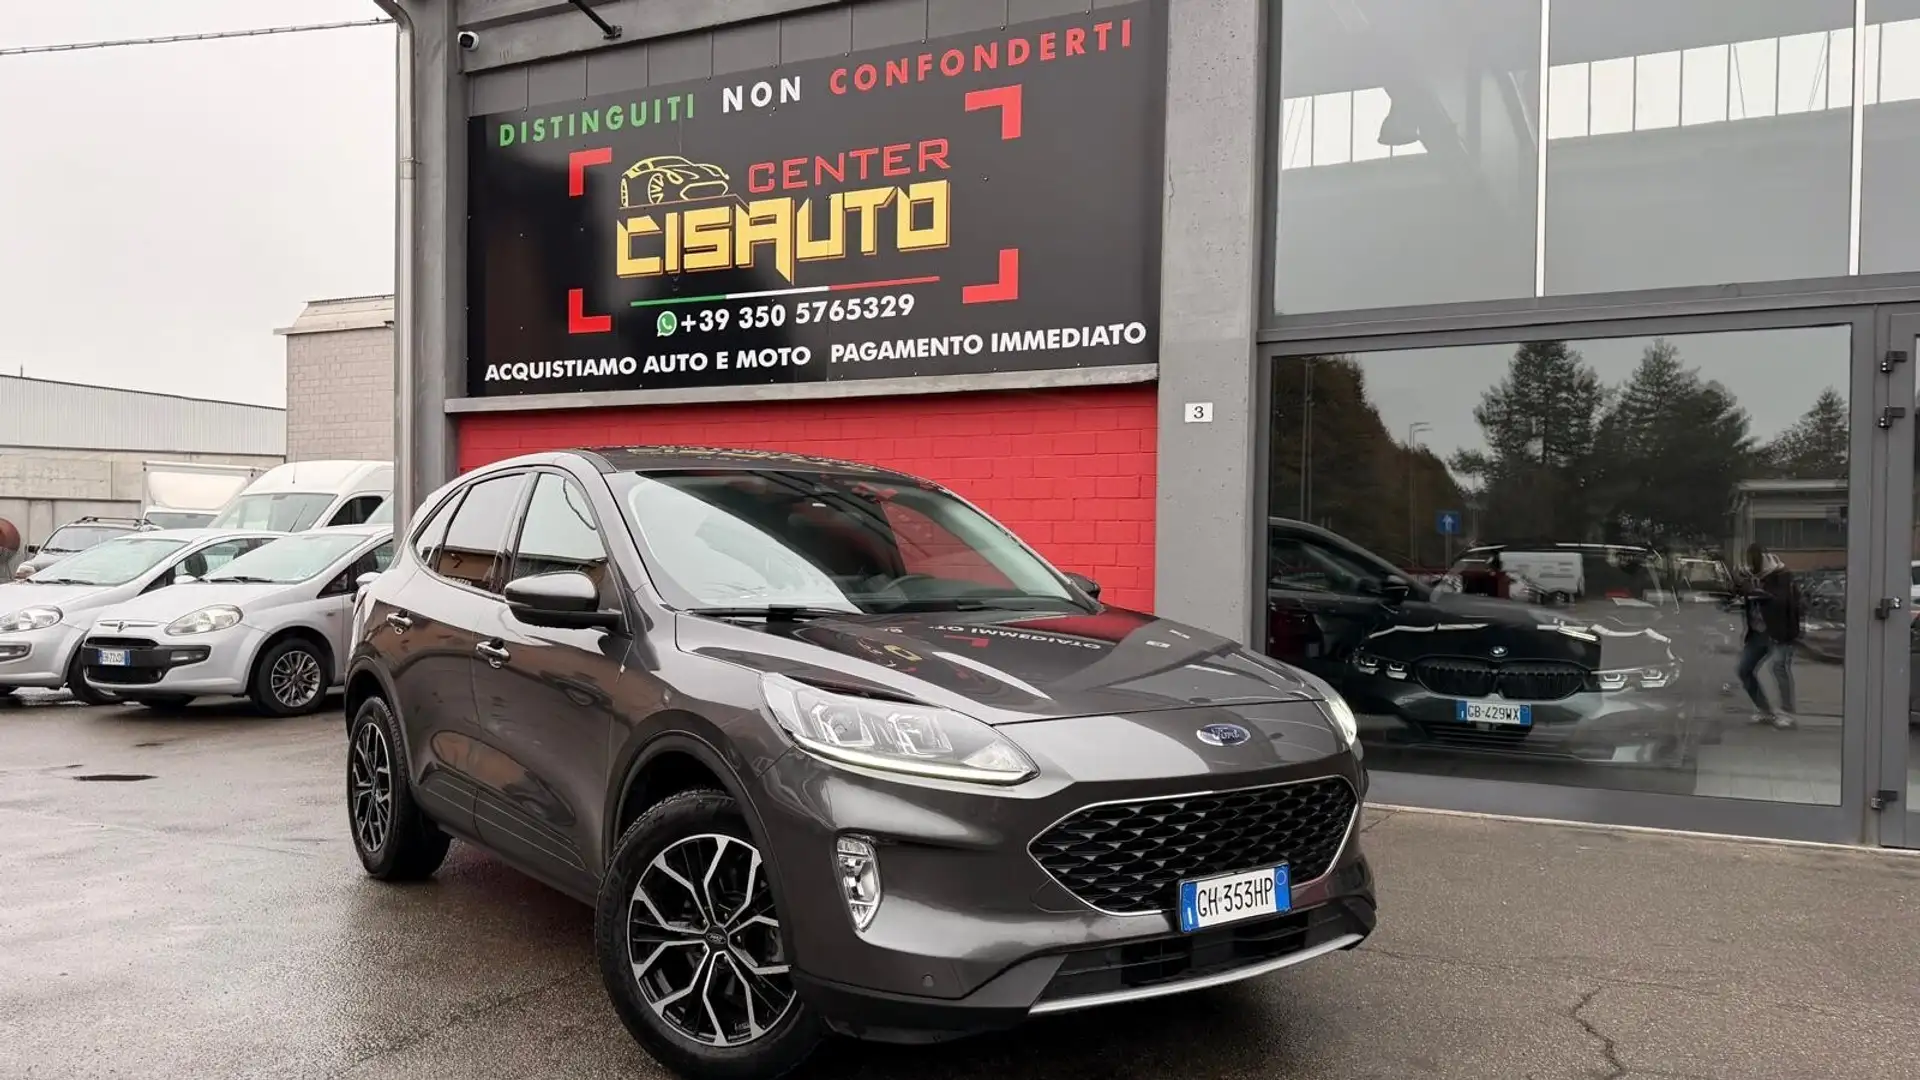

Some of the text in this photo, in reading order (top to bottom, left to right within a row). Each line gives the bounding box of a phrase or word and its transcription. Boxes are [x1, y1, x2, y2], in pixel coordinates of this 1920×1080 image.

[500, 19, 1131, 146] DISTINGUITI NON CONFONDERTI
[748, 138, 951, 193] CENTER
[616, 179, 950, 285] CISAUTO
[680, 293, 915, 332] +39 350 5765329
[831, 321, 1147, 363] PAGAMENTO IMMEDIATO
[485, 346, 811, 381] ACQUISTIAMO AUTO E MOTO
[1193, 405, 1204, 419] 3
